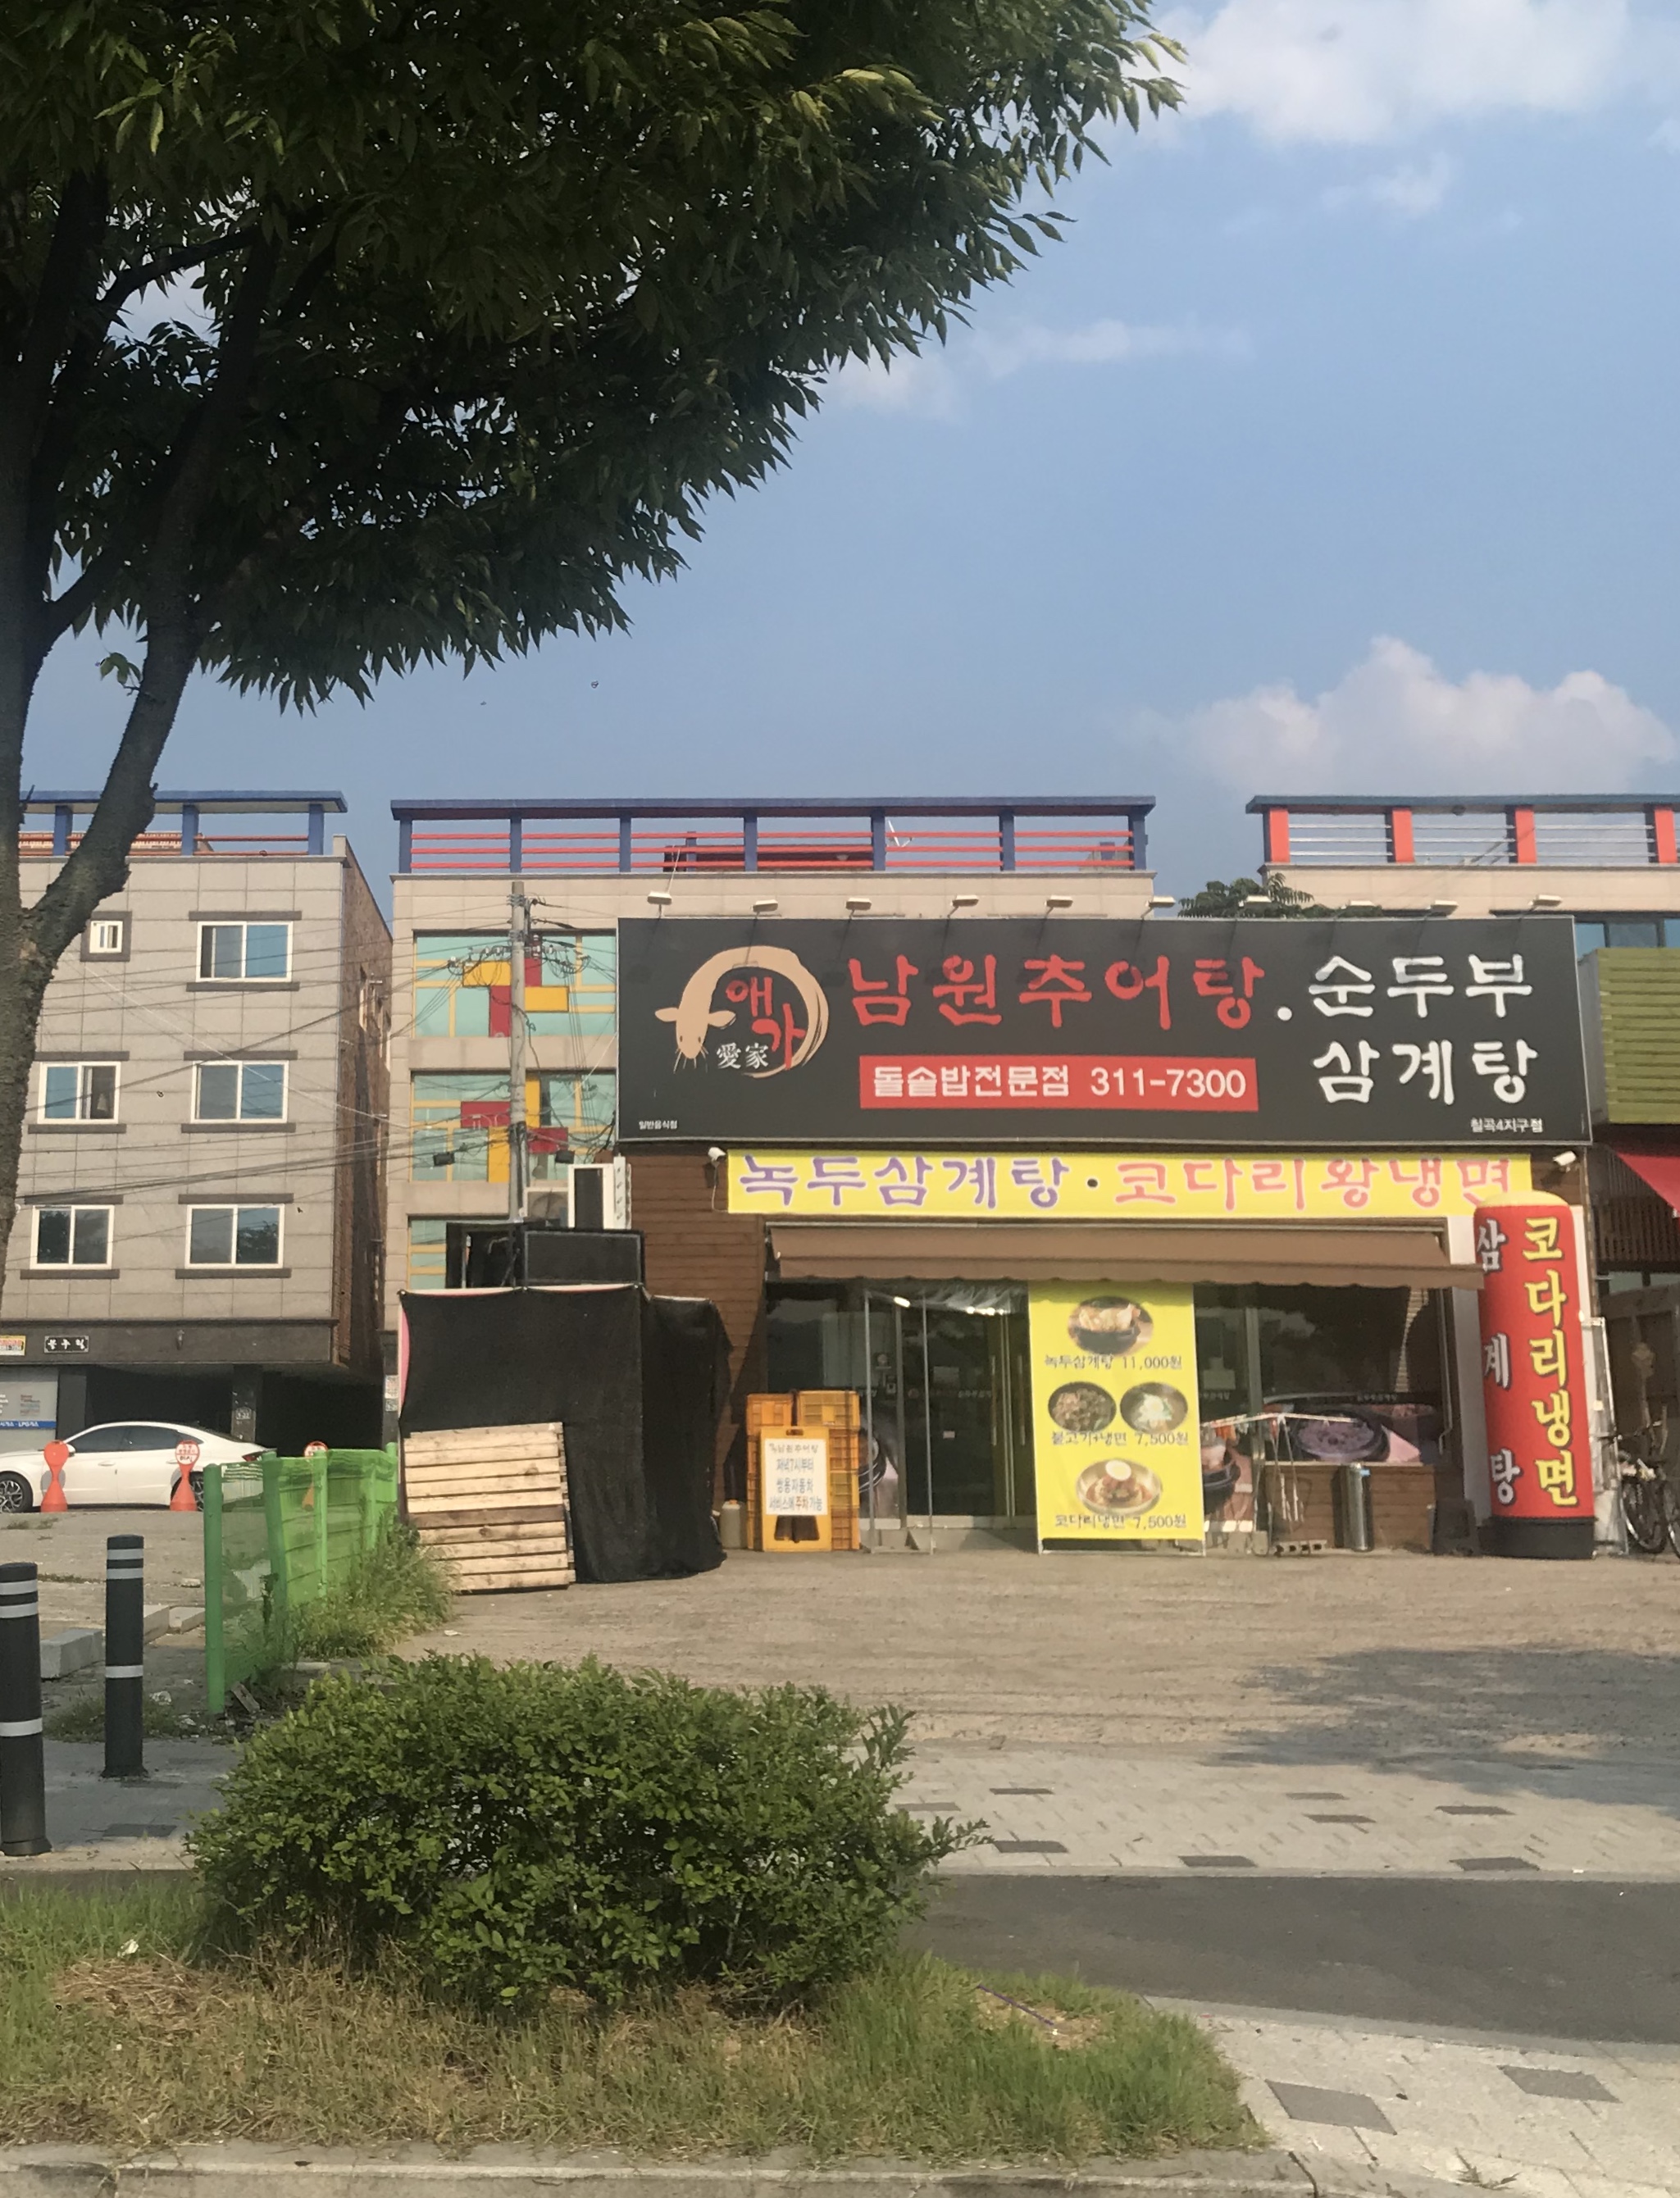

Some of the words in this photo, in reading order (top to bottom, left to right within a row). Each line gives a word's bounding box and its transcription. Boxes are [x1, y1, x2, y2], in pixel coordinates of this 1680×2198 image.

[849, 953, 1265, 1031] 남원추어탕
[1309, 953, 1533, 1018] 순두부
[716, 1041, 769, 1069] 愛家
[1313, 1039, 1539, 1105] 삼계탕
[873, 1065, 1070, 1098] 돌솥밥전문점
[1090, 1067, 1247, 1098] 311-7300
[740, 1154, 1071, 1209] 녹두삼계탕
[1114, 1158, 1511, 1212] 코다리왕냉면
[1045, 1354, 1114, 1370] 녹두삼계탕
[1122, 1355, 1182, 1371] 11,000원
[1476, 1218, 1522, 1507] 삼계탕
[1522, 1216, 1578, 1507] 코다리냉면
[1134, 1431, 1189, 1447] 7,500원
[1055, 1514, 1125, 1529] 코다리냉면
[1132, 1513, 1187, 1531] 7,500원
